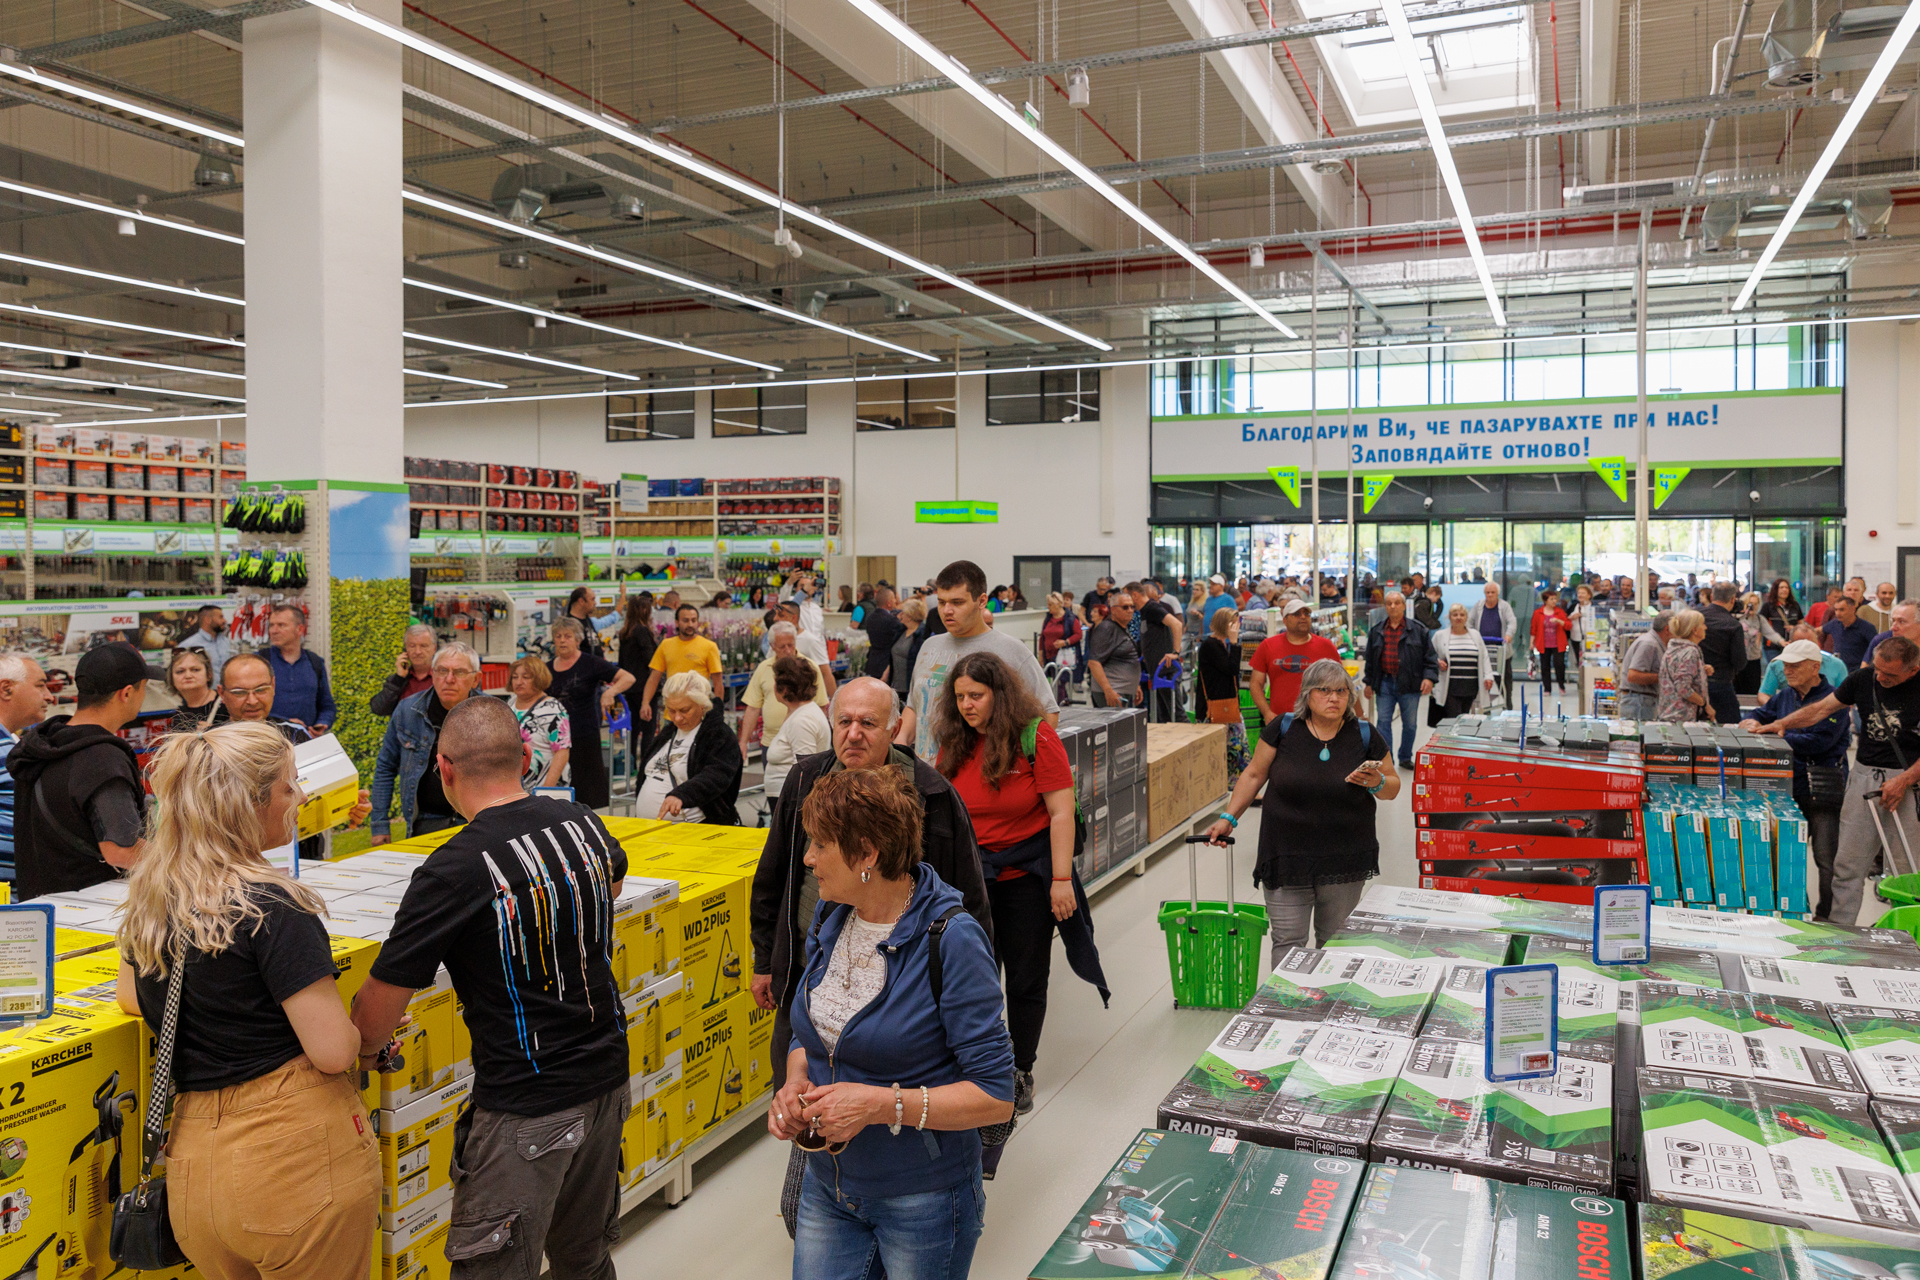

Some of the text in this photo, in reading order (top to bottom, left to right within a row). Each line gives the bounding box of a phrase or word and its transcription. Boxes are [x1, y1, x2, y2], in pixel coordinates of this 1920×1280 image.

[1289, 478, 1295, 489] 1
[1612, 470, 1621, 481] 3
[1660, 480, 1669, 491] 4
[1368, 487, 1375, 496] 2
[110, 616, 134, 625] SKIL
[1286, 951, 1309, 970] RAIDER
[1452, 968, 1471, 989] RAIDER
[1224, 1021, 1254, 1047] RAIDER
[32, 1042, 93, 1070] KÄRCHER
[1414, 1044, 1436, 1072] RAIDER
[1825, 1054, 1854, 1085] RAIDER
[0, 1100, 57, 1124] HDRUCKREINIGER
[4, 1103, 67, 1132] PRESSURE WASHER
[1168, 1119, 1239, 1140] RAIDER
[1318, 1143, 1335, 1152] 1400
[1339, 1147, 1355, 1156] 3400
[0, 1174, 25, 1188] supported
[1270, 1172, 1289, 1196] ARM 32
[1554, 1184, 1573, 1193] 1400
[1294, 1178, 1340, 1232] BOSCH
[1866, 1176, 1910, 1223] RAIDER
[1536, 1214, 1550, 1240] ARM 32
[1577, 1220, 1611, 1280] BOSCH
